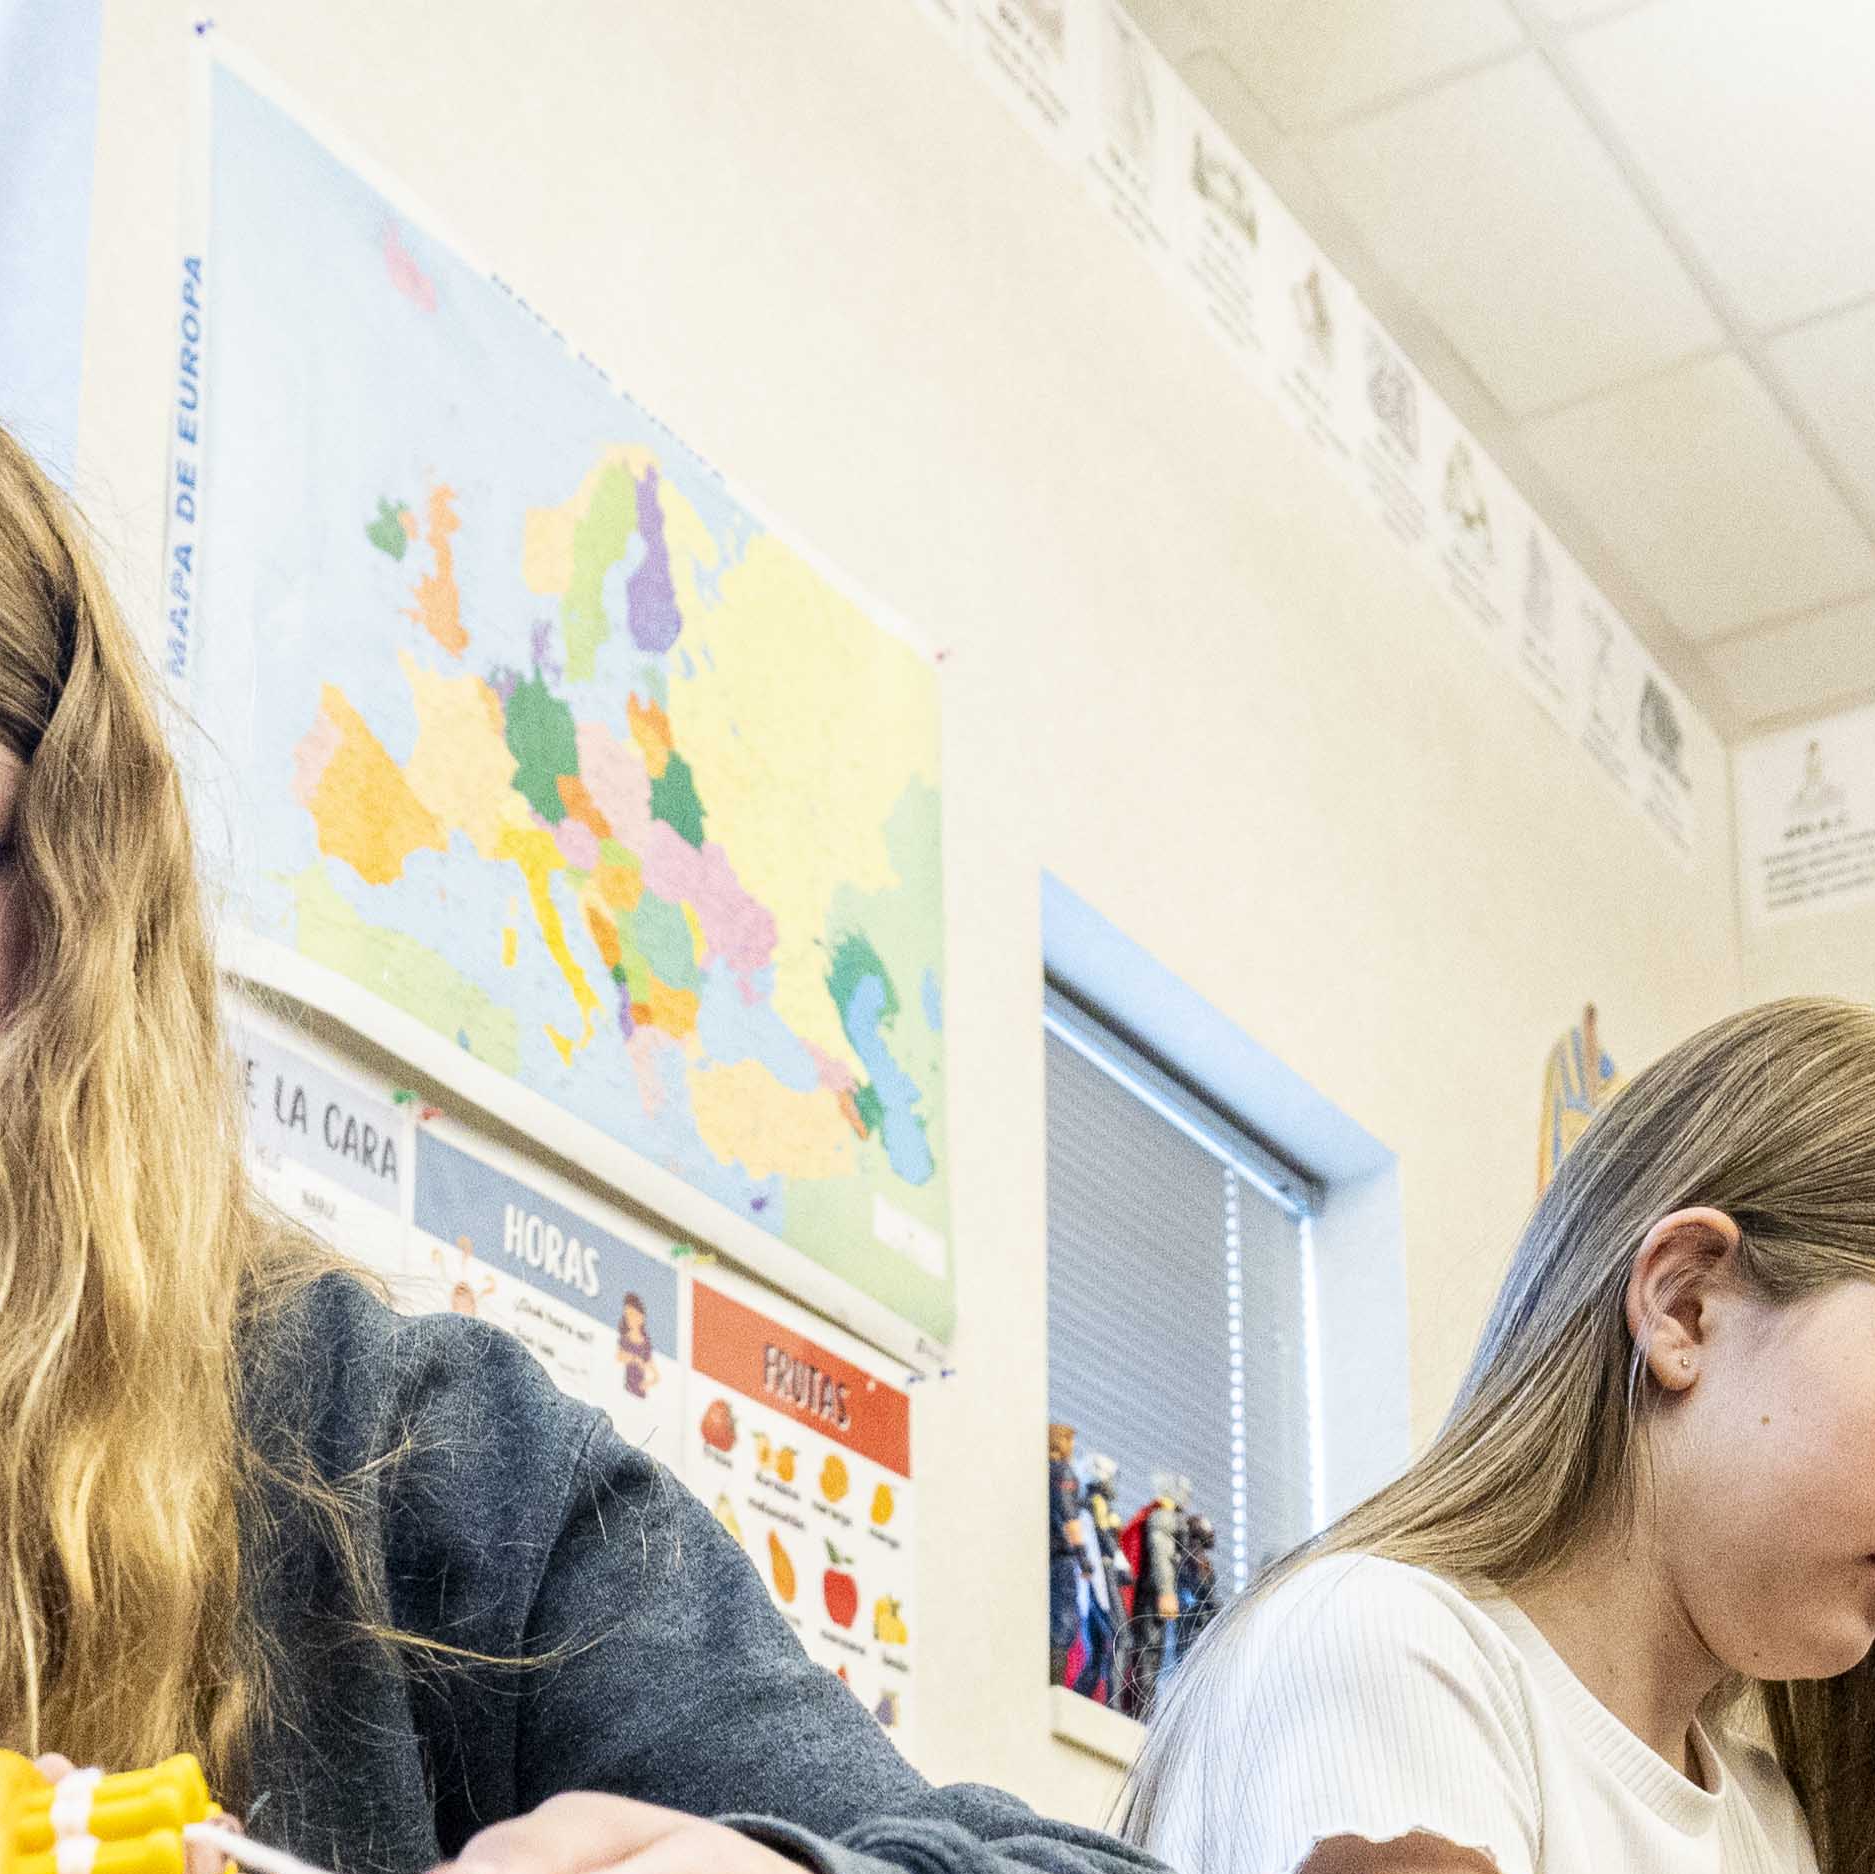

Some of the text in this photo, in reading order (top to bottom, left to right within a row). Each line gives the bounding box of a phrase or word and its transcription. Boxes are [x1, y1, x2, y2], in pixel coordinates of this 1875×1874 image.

[177, 254, 203, 446] EUROPA
[175, 460, 198, 524] DE
[274, 1074, 308, 1134] LA
[322, 1101, 399, 1185] CARA
[504, 1203, 601, 1298] HORAS
[761, 1341, 852, 1433] FRUTAS
